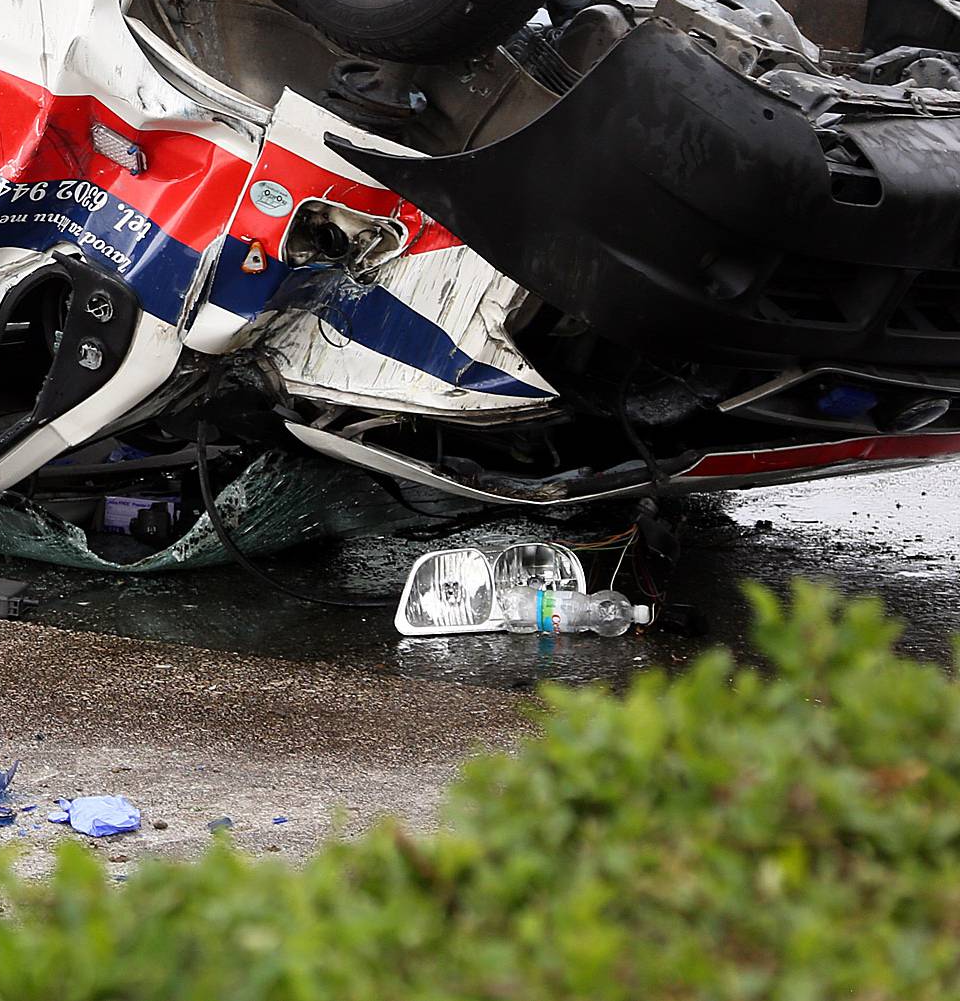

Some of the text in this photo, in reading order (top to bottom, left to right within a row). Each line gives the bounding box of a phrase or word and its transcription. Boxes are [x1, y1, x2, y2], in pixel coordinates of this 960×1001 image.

[56, 180, 108, 212] 6302
[68, 221, 84, 237] za
[113, 203, 152, 242] tel.
[79, 231, 131, 274] Zavod
